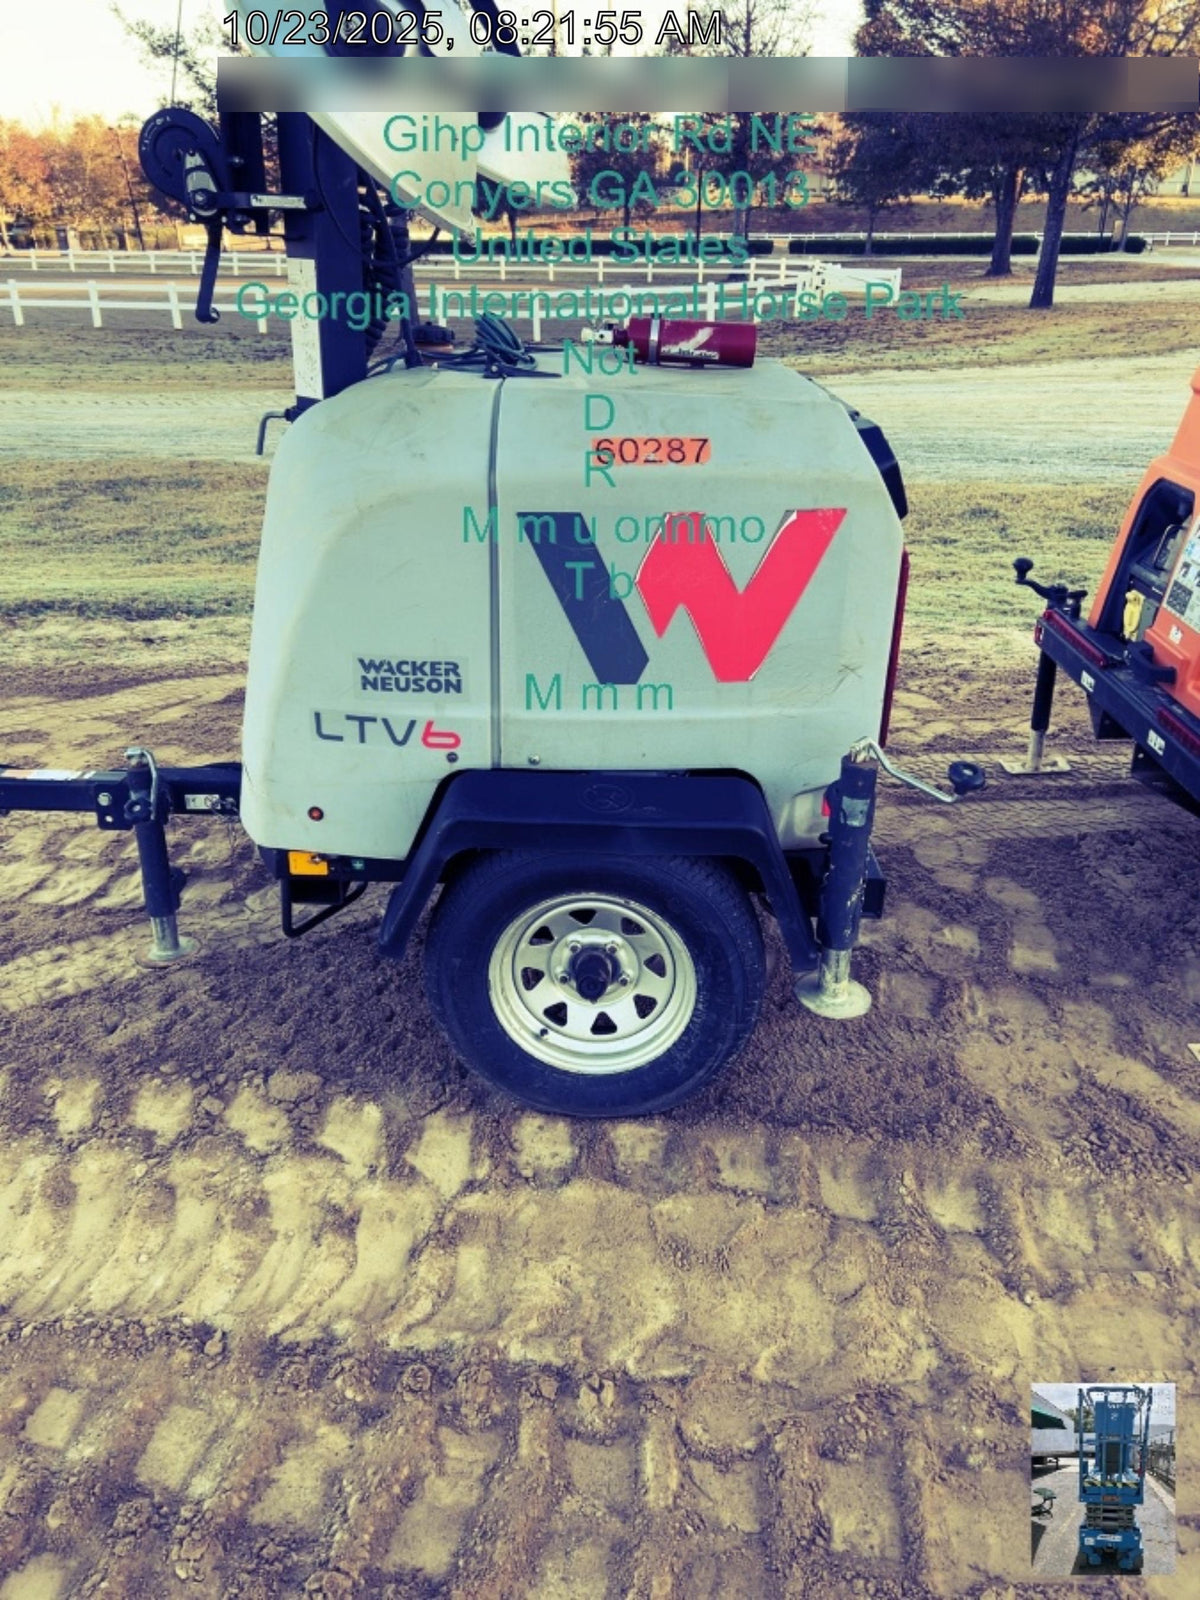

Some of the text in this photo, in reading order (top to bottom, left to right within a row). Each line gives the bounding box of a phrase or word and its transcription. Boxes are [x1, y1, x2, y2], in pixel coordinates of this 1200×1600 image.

[595, 437, 710, 465] 60287
[357, 657, 461, 678] WACKER
[360, 675, 462, 694] NEUSON
[314, 711, 461, 749] LTV6
